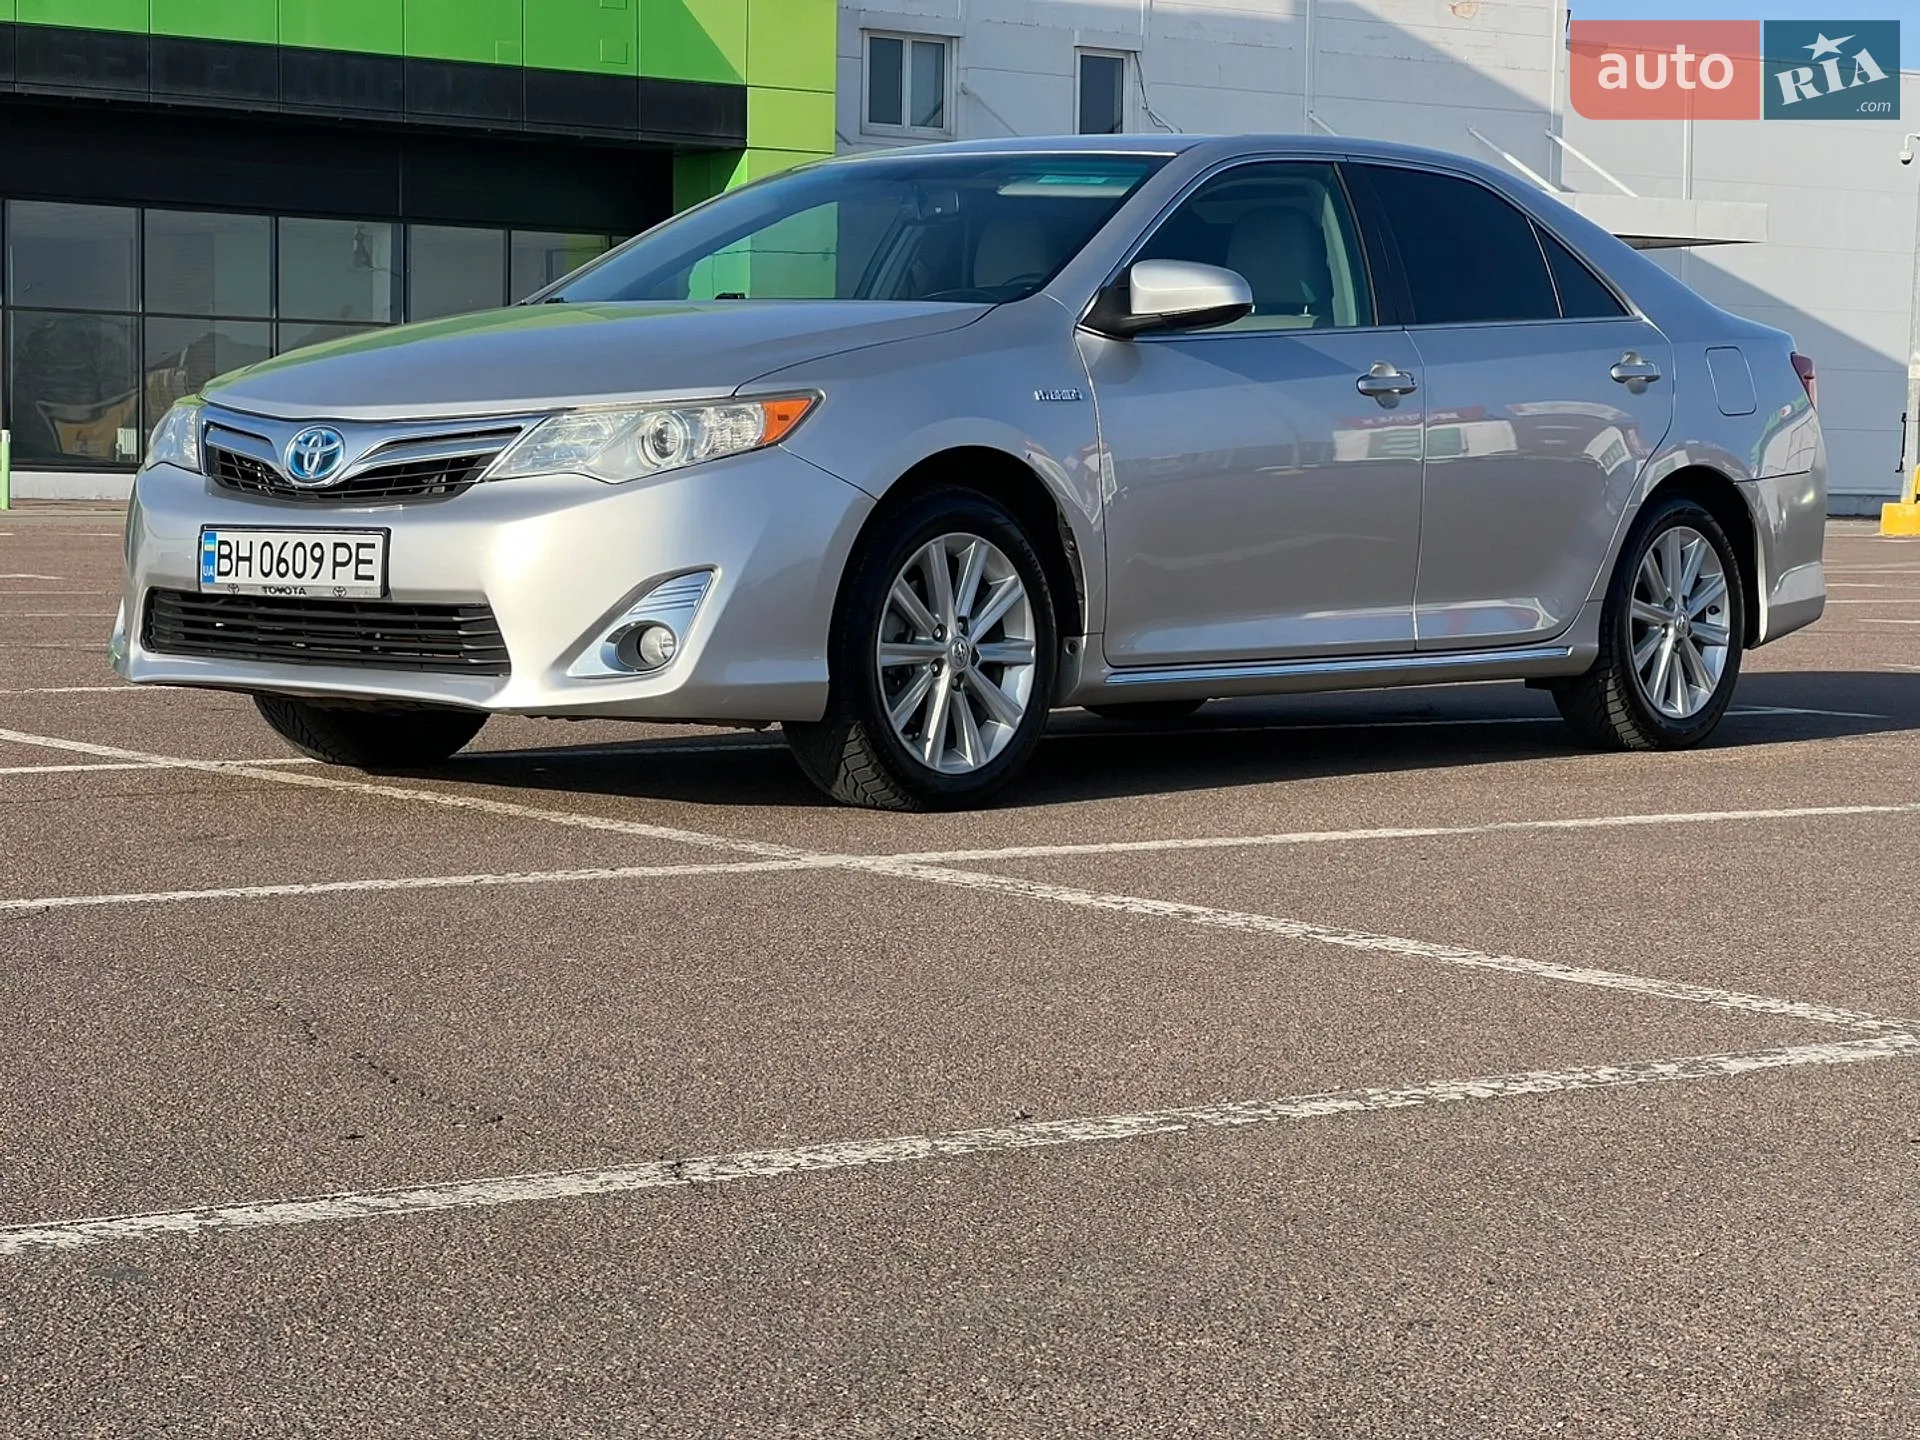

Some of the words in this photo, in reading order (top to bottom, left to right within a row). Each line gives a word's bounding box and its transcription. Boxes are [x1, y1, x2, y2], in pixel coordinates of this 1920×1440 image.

[217, 540, 253, 578] BH
[260, 541, 325, 580] 0609
[332, 542, 376, 581] PE
[203, 564, 215, 577] UA
[262, 586, 306, 595] TOYOTA
